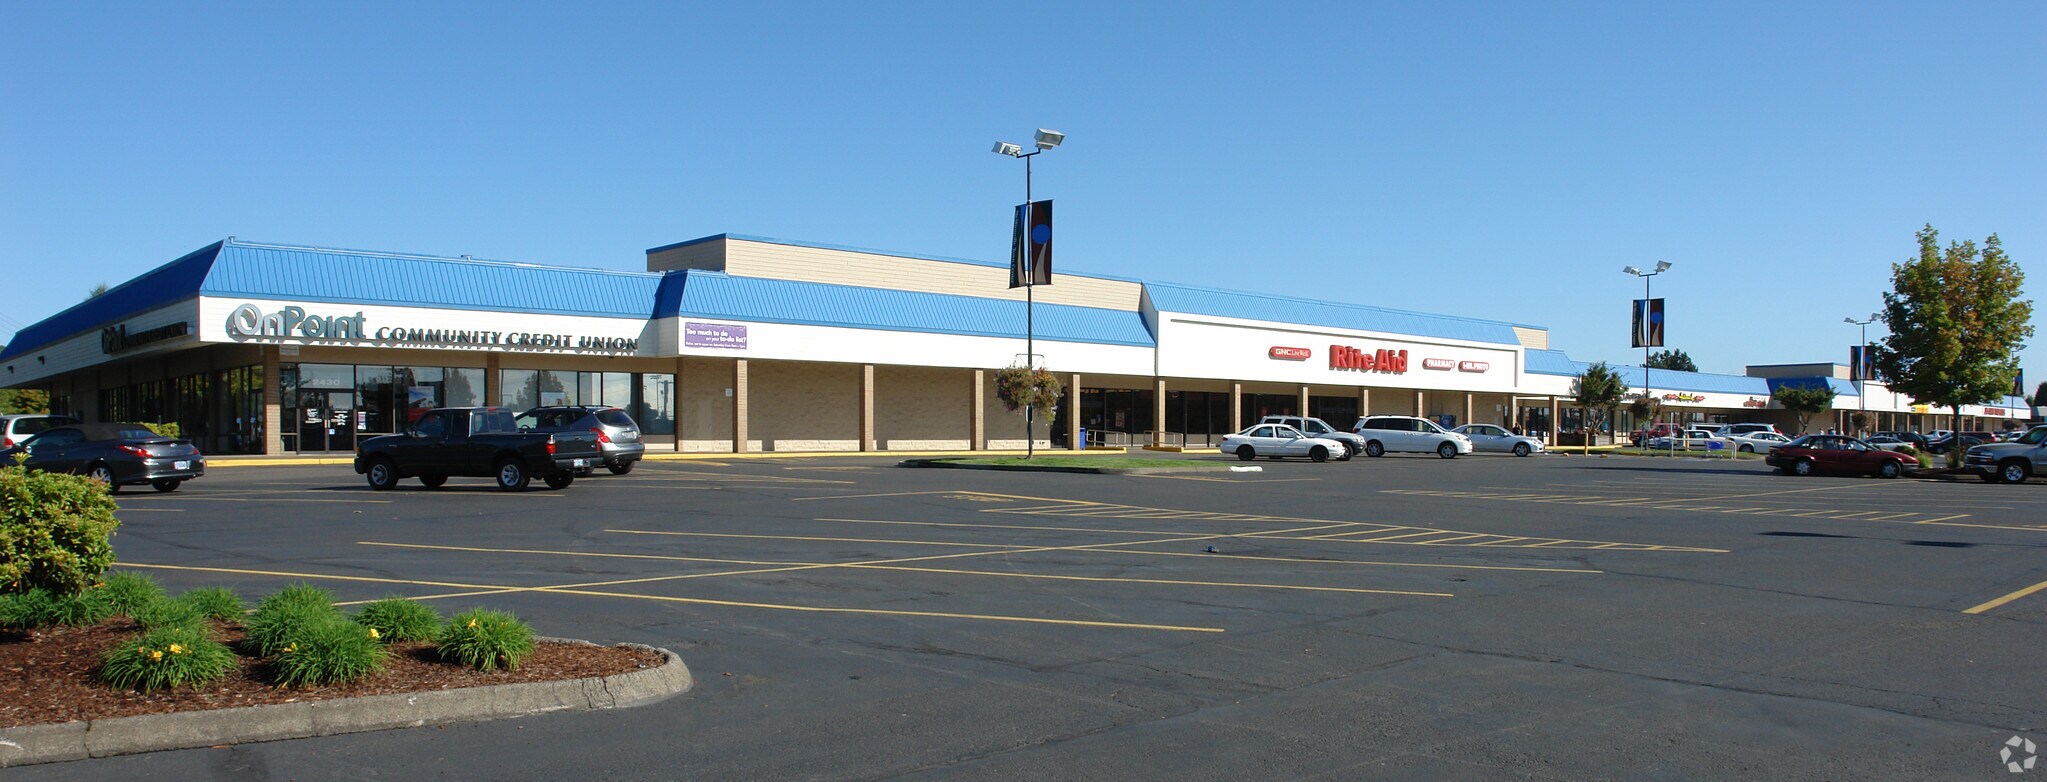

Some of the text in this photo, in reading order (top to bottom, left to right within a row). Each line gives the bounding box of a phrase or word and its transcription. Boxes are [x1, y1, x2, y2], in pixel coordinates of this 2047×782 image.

[230, 303, 638, 350] OnPoint COMMUNITY CREDIT UNION
[1275, 348, 1291, 356] GNC
[1329, 345, 1408, 372] Rite Aid
[1427, 359, 1455, 368] PHARMACY
[312, 378, 340, 386] 2430
